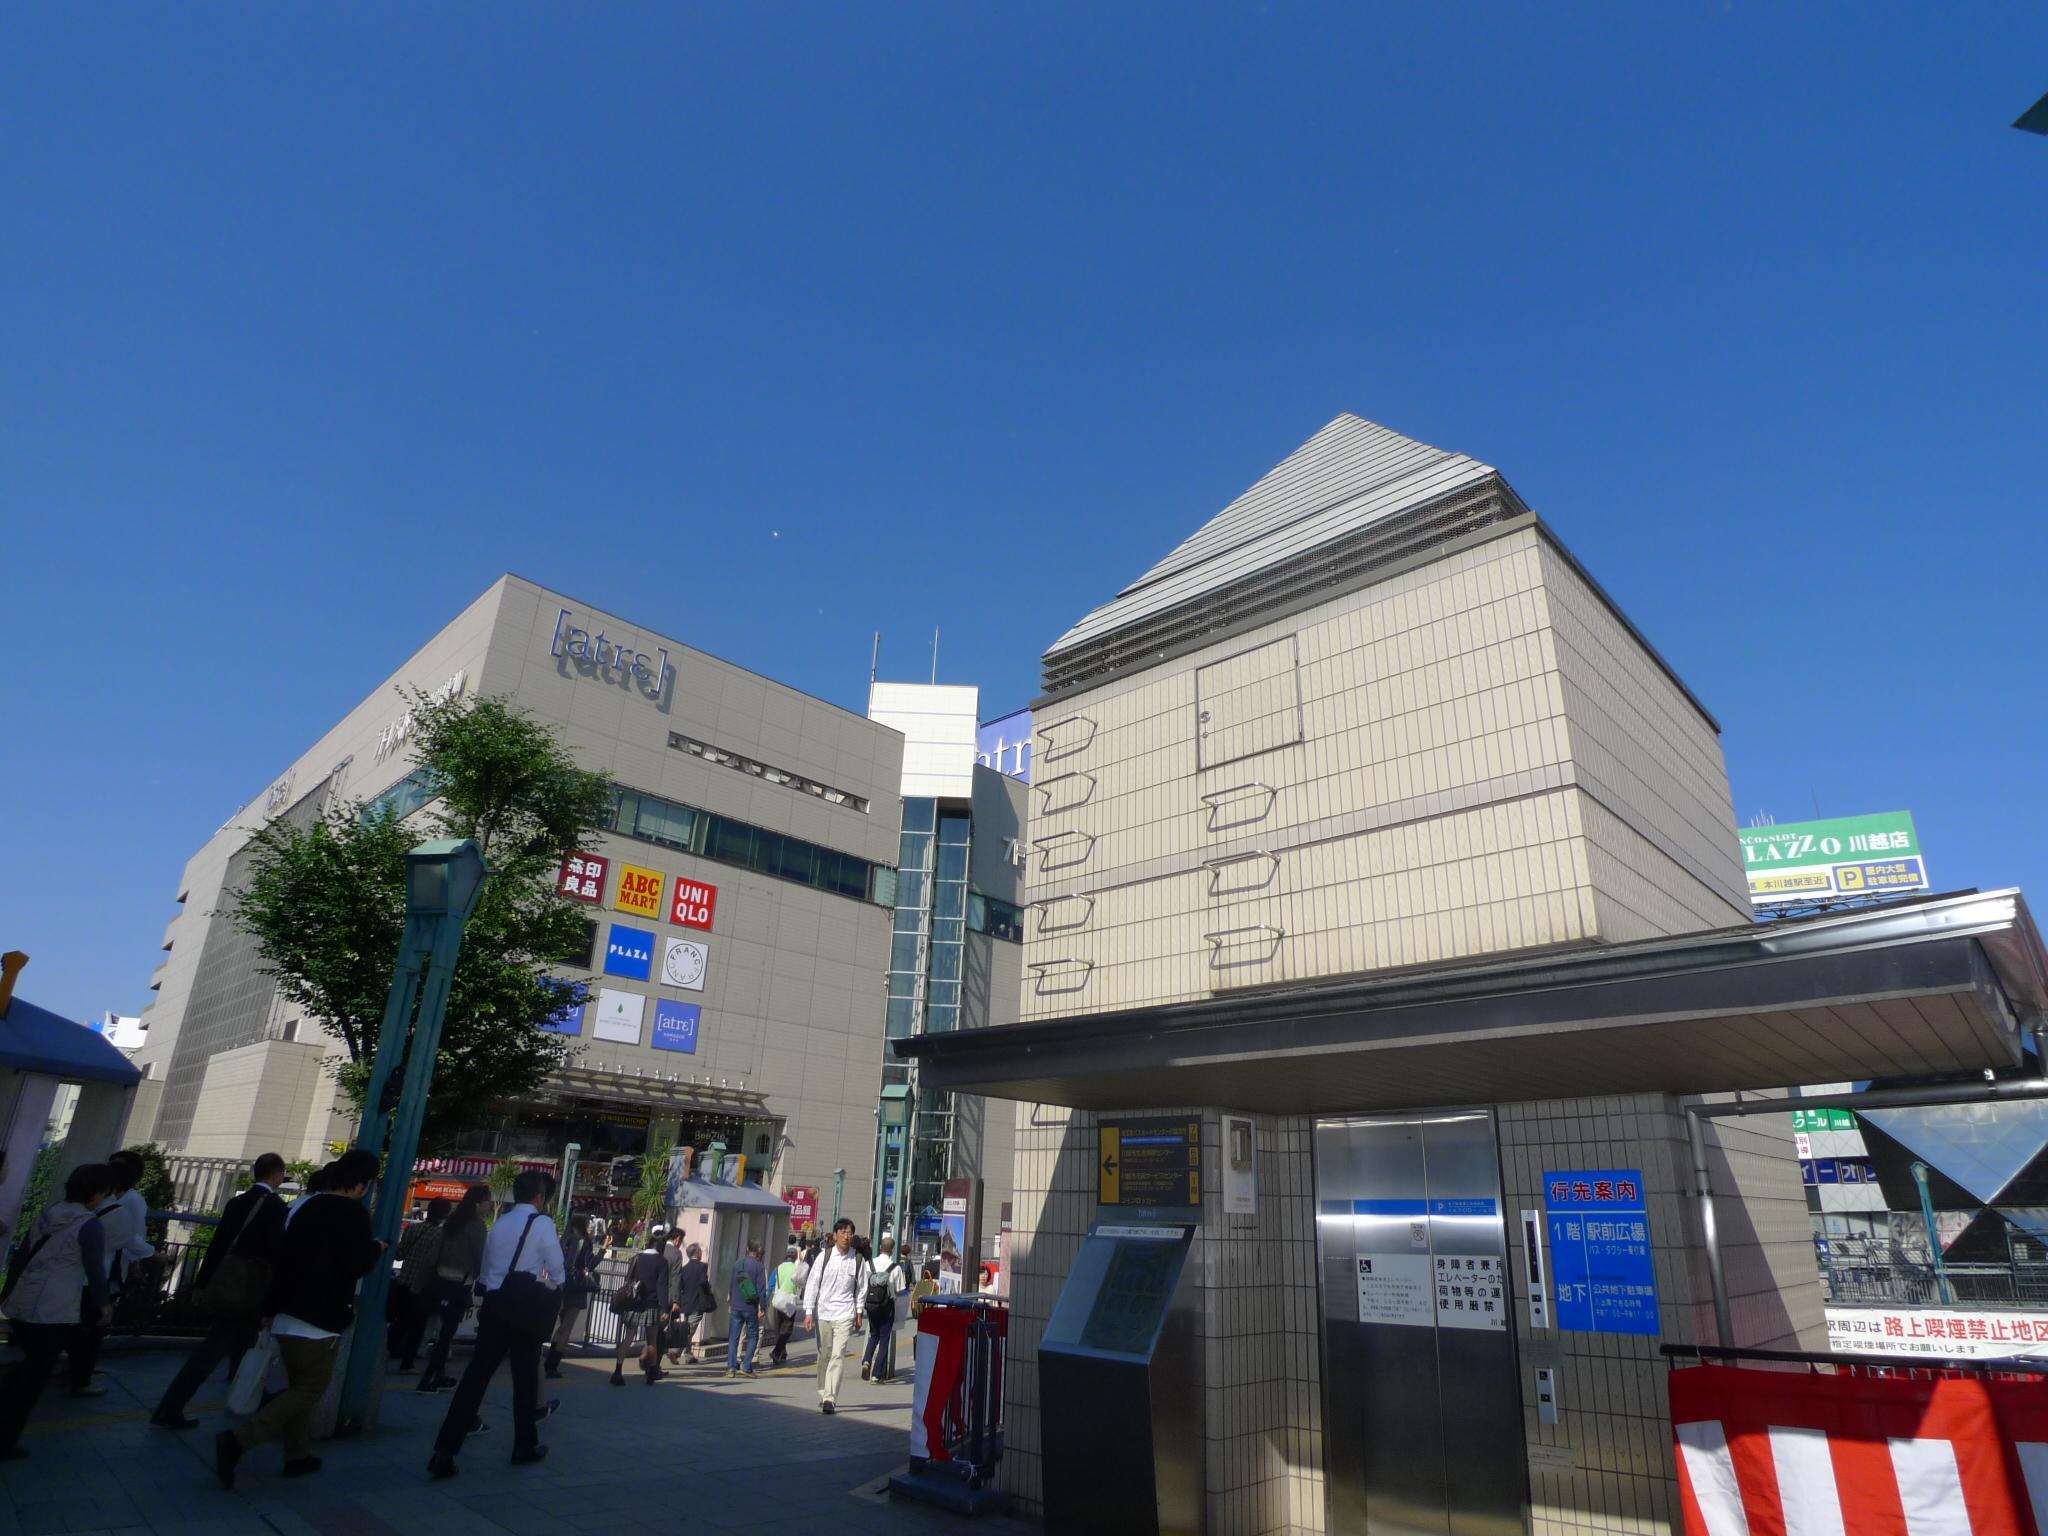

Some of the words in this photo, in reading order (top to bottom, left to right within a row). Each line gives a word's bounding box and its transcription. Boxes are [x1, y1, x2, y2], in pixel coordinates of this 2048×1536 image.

[1745, 835, 1841, 862] LAZZO
[1849, 831, 1910, 852] 川越店
[567, 858, 602, 878] 無印
[564, 876, 597, 898] 良品
[622, 872, 660, 895] ABC
[679, 883, 709, 903] UNI
[619, 891, 657, 910] MART
[676, 903, 708, 923] QLO
[610, 944, 649, 961] PLAZA
[1793, 1117, 1828, 1128] クール
[443, 1187, 468, 1195] Kitche
[1551, 1181, 1638, 1202] 行先案内
[1553, 1222, 1581, 1241] 1階
[1586, 1222, 1646, 1242] 駅前広場
[1439, 1299, 1495, 1312] 使用厳禁
